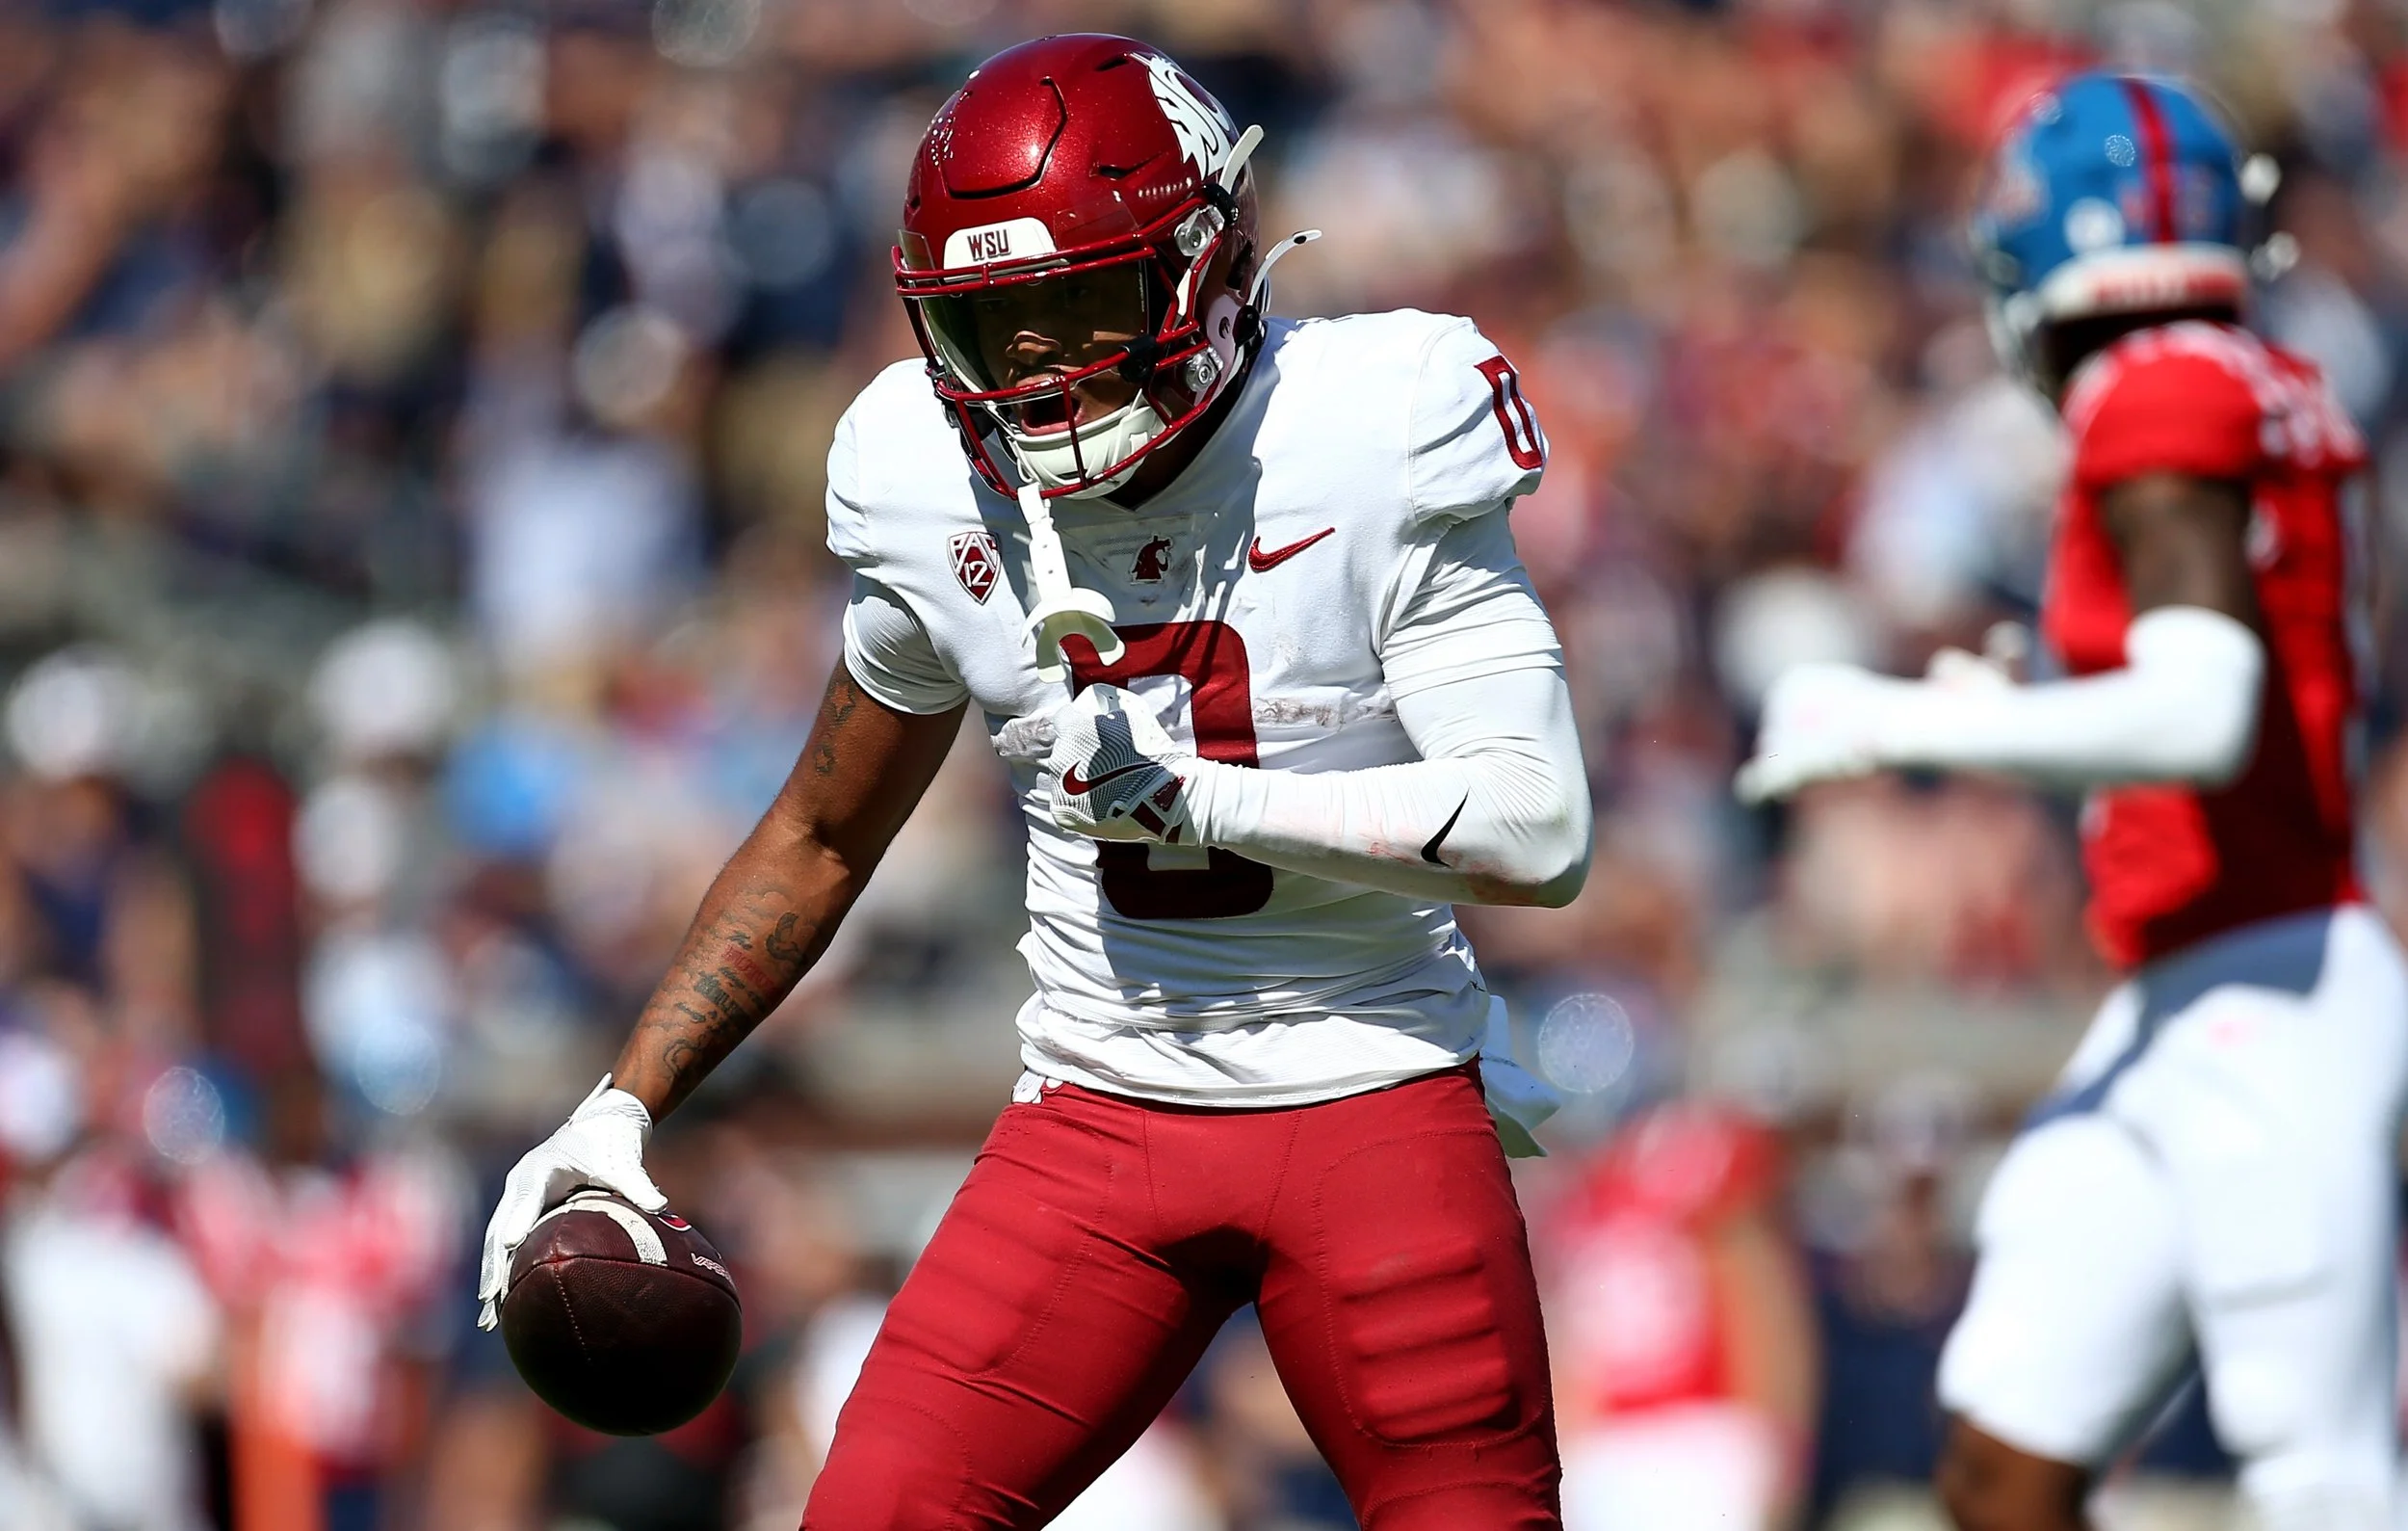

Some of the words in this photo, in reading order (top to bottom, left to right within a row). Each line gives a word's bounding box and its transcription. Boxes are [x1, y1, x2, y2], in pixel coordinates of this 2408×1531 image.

[967, 228, 1011, 262] WSU
[1474, 355, 1543, 471] 0
[948, 531, 998, 574] PAC
[963, 560, 990, 588] 12
